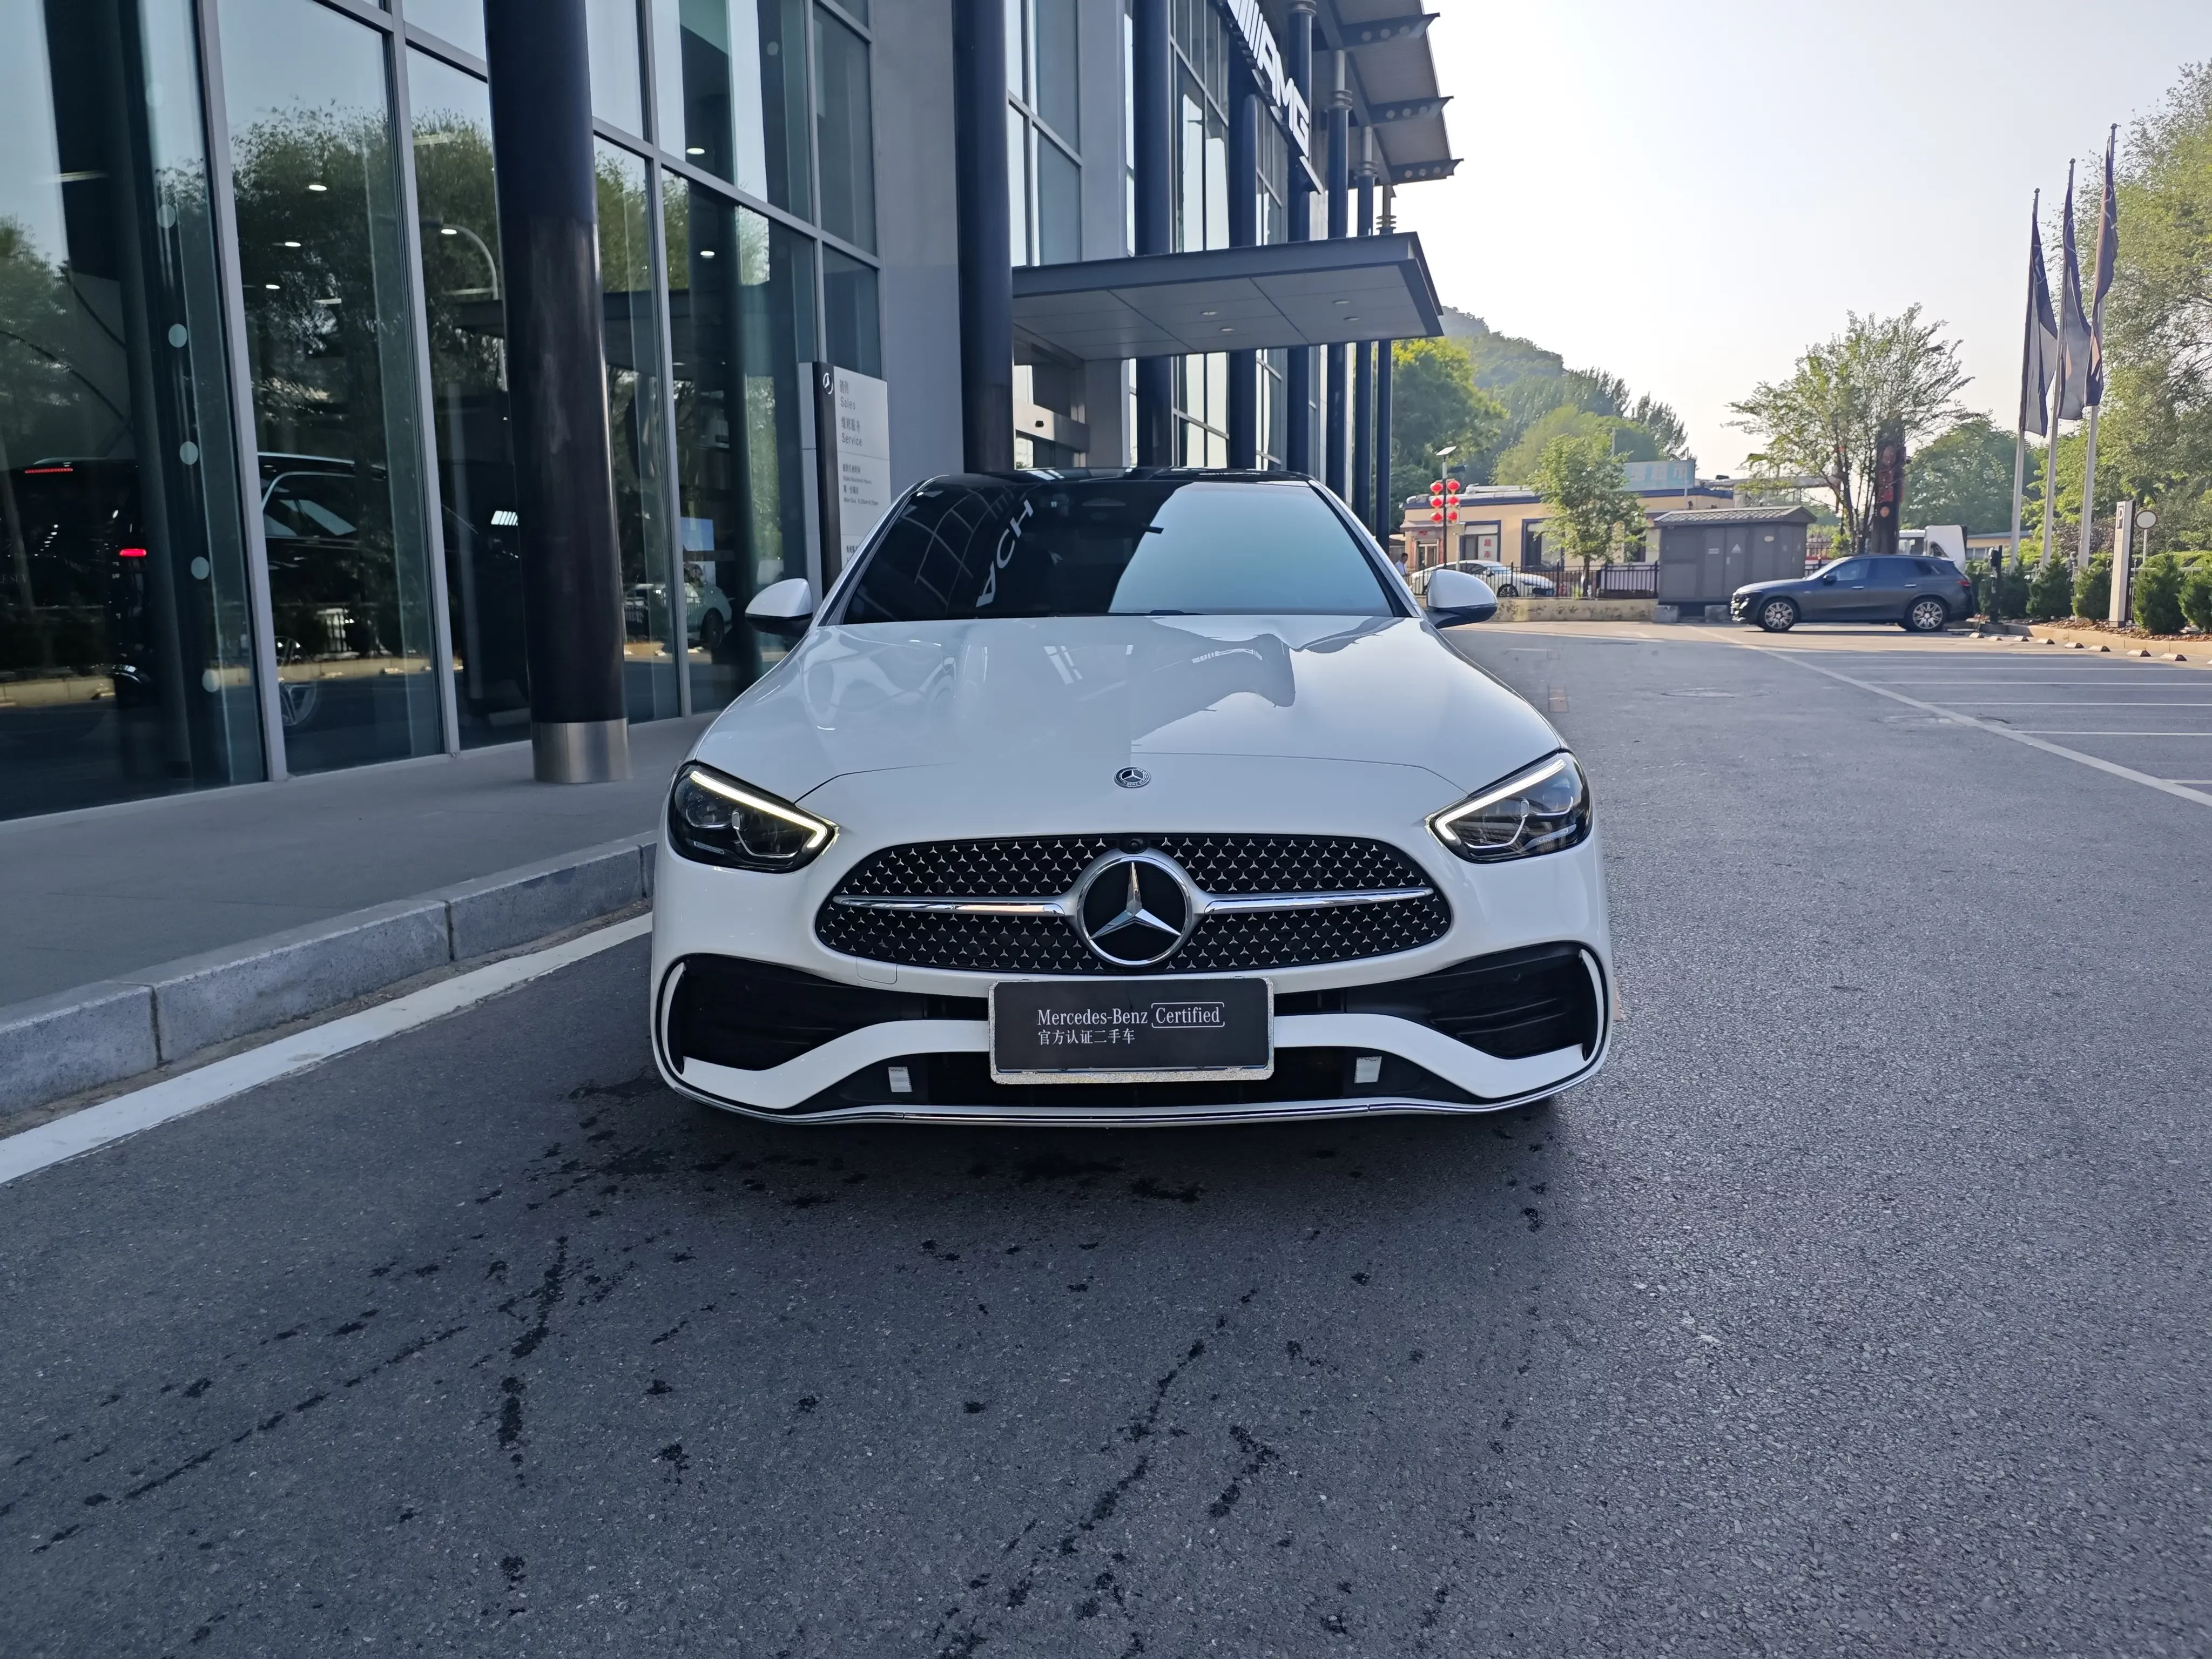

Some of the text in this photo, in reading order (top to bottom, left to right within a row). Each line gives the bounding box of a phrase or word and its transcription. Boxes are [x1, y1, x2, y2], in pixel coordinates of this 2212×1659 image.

[1257, 21, 1310, 158] AMG
[840, 396, 855, 410] Sales
[841, 432, 862, 447] Service
[2117, 507, 2123, 528] P
[1037, 1007, 1220, 1026] Mercedes-Benz Certified
[1037, 1027, 1135, 1046] 官方认证二手车
